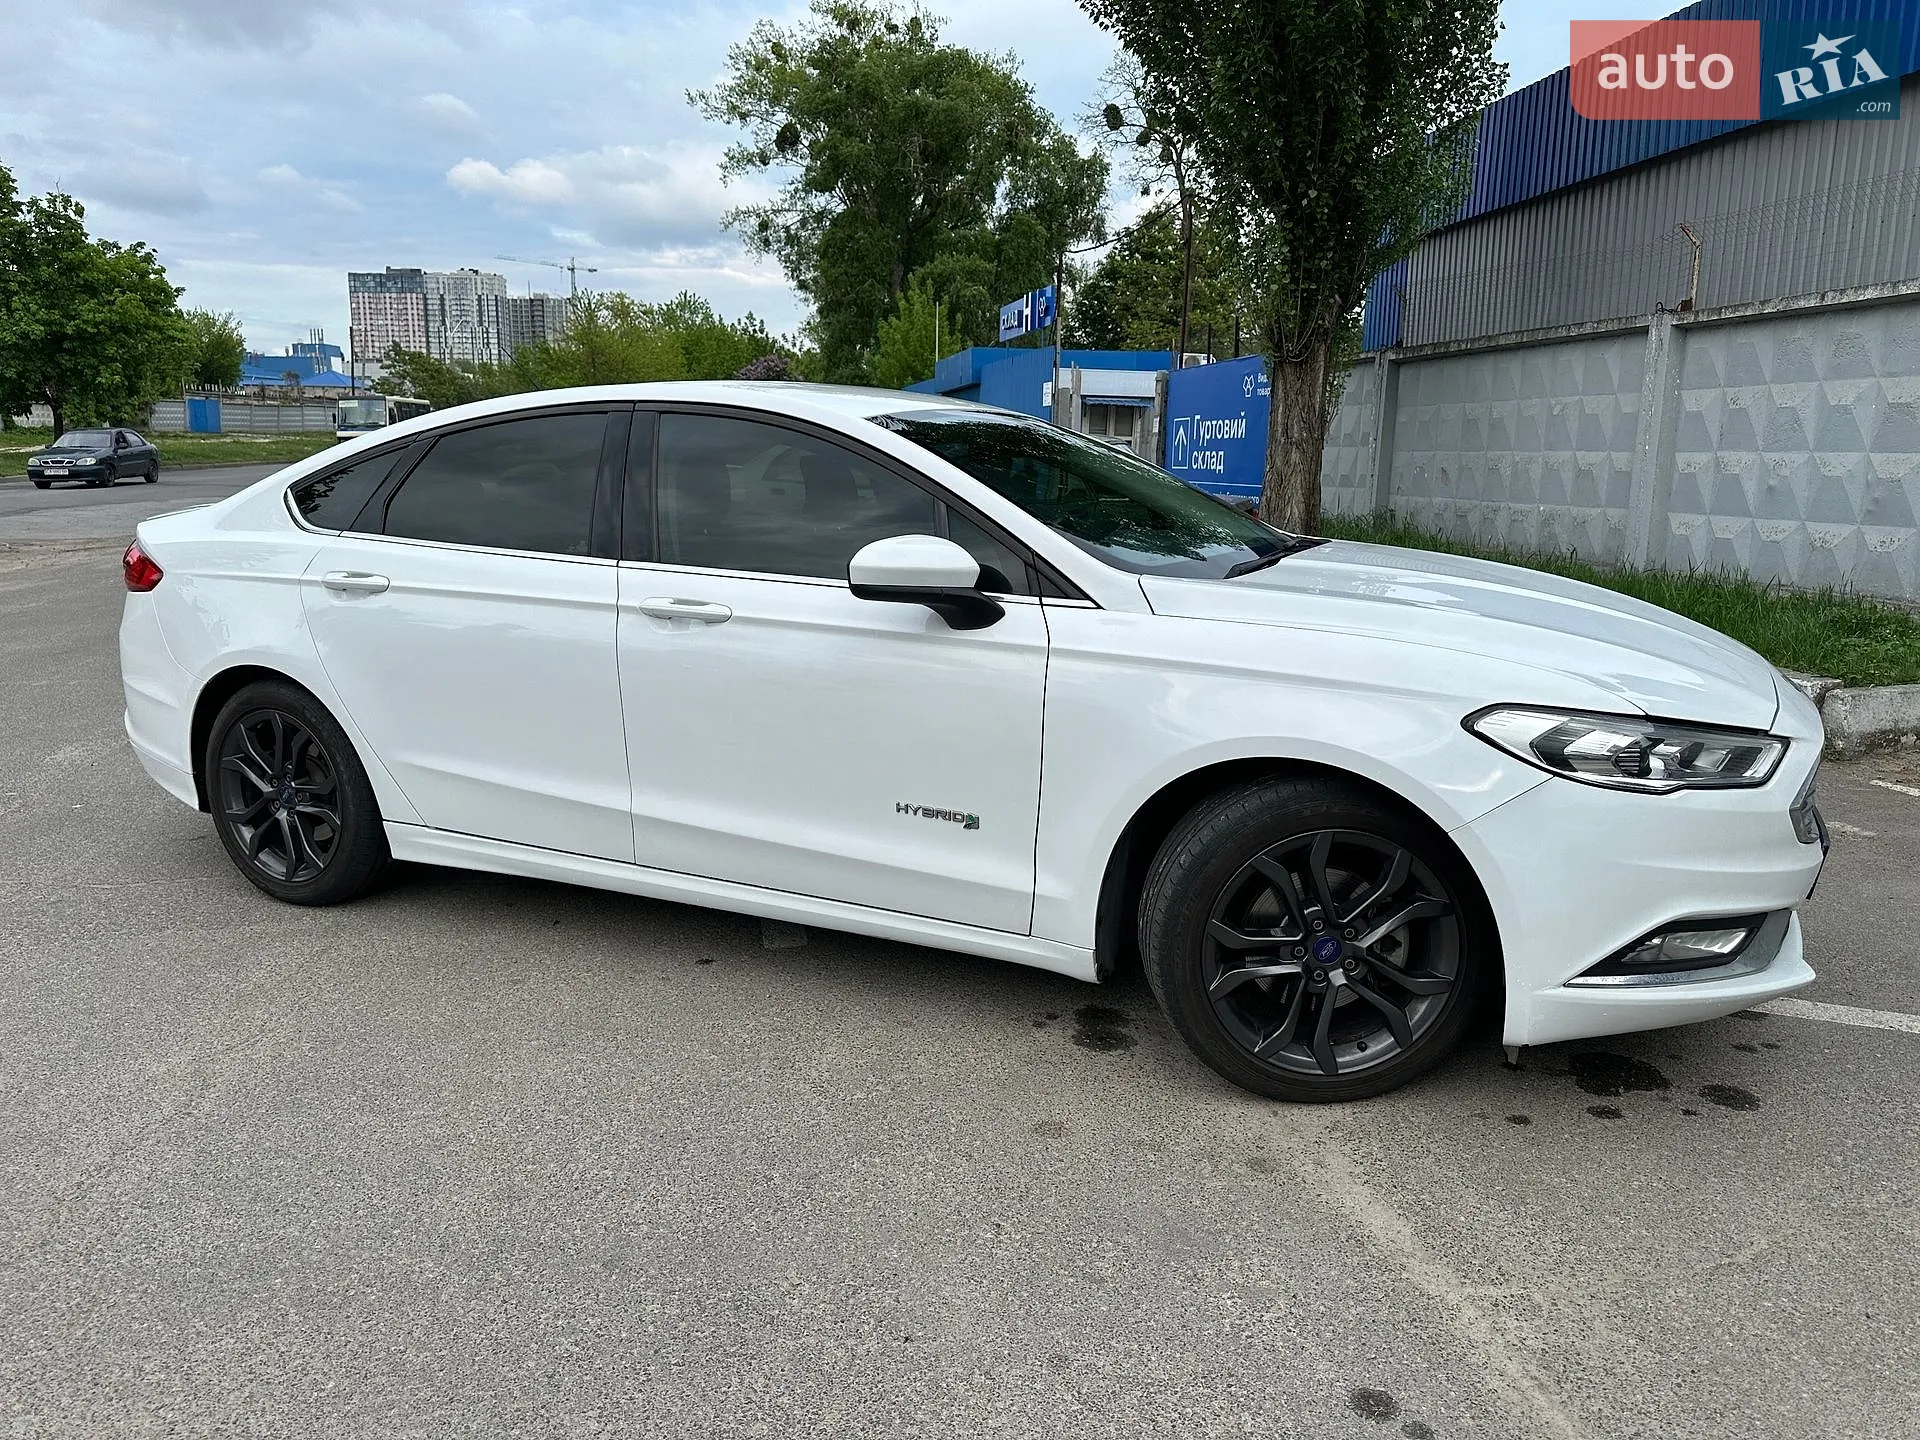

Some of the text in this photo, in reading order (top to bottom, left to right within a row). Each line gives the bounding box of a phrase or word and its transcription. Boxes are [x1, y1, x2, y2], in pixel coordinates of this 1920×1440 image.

[1193, 410, 1246, 447] Гуртовий
[1192, 450, 1224, 474] склад
[895, 801, 964, 823] HYBRID
